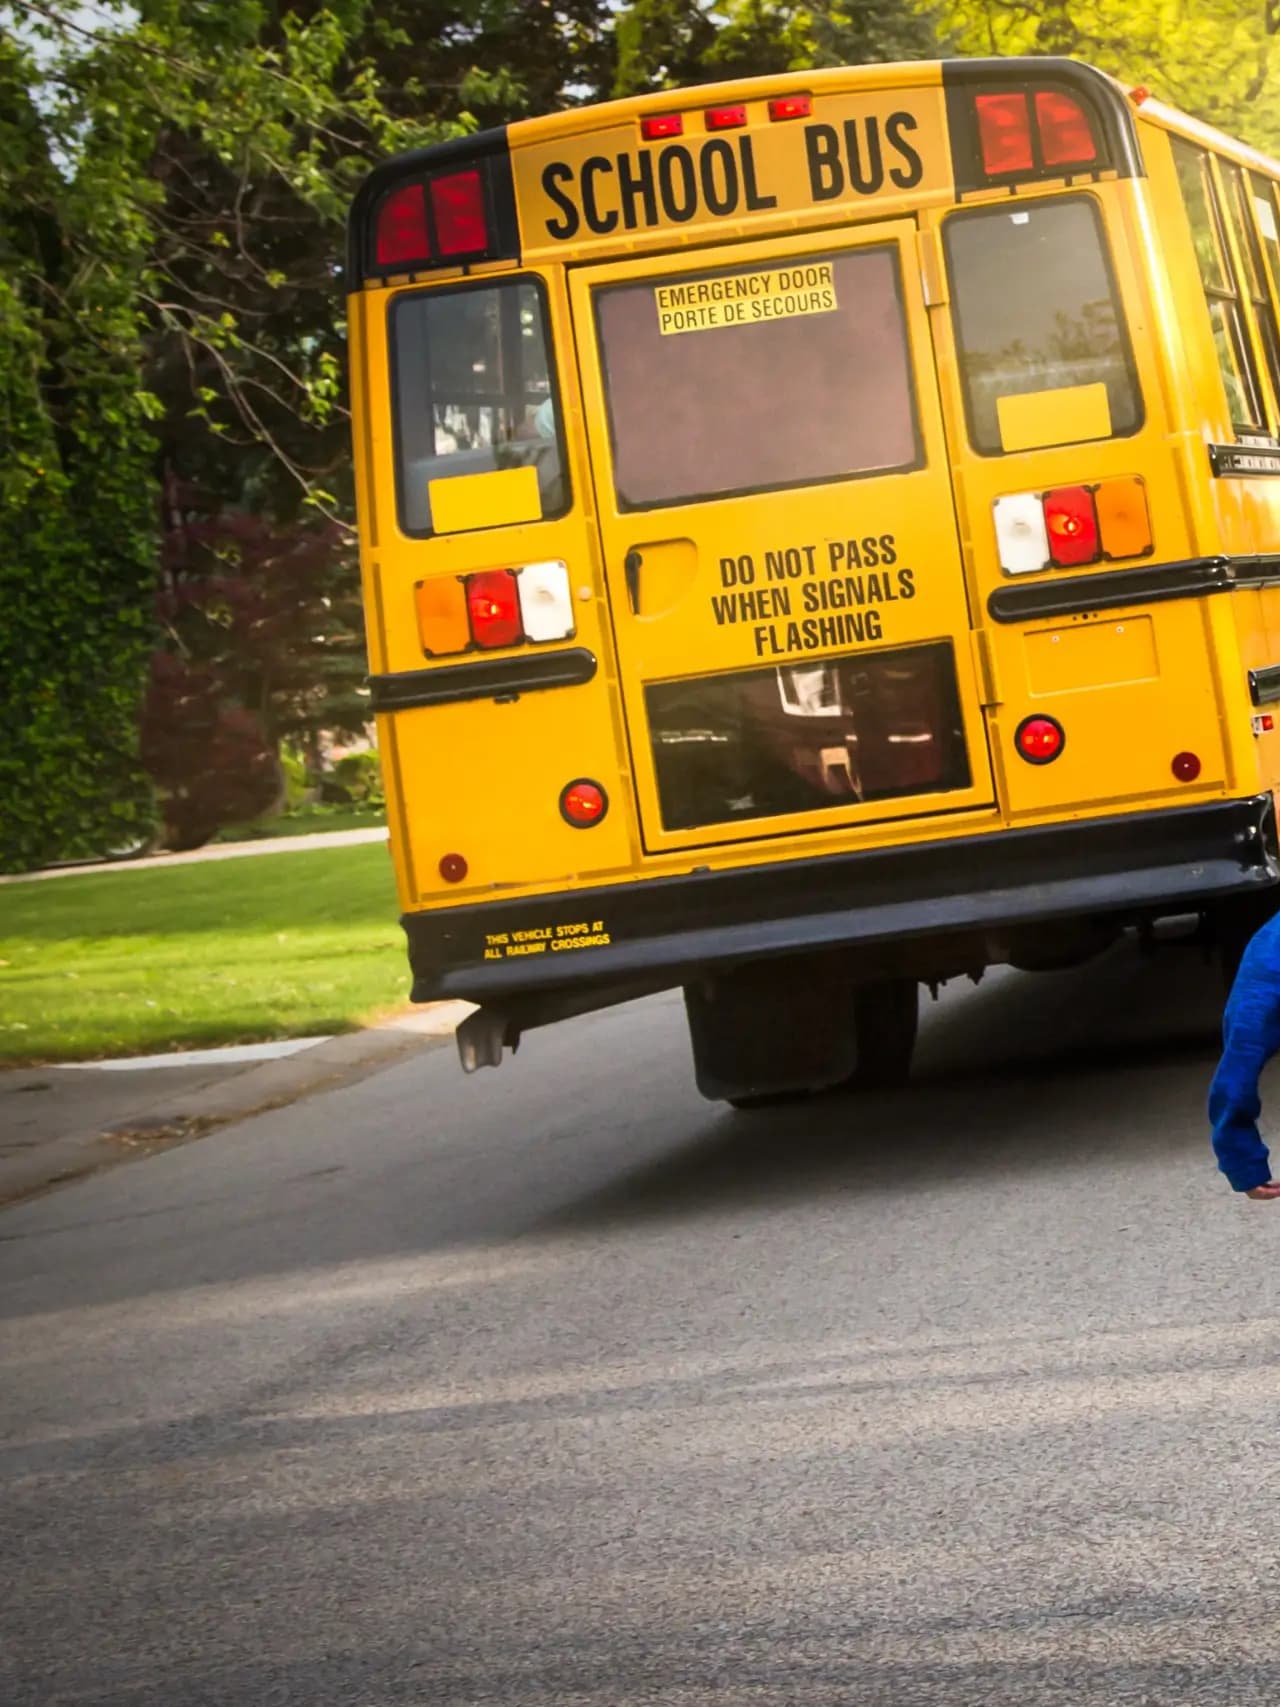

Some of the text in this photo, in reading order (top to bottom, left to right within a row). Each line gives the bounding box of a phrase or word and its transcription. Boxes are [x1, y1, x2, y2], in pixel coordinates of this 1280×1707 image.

[541, 111, 924, 240] SCHOOL BUS
[658, 266, 832, 309] EMERGENCY DOOR
[662, 290, 833, 332] PORTE DE SECOURS
[719, 534, 897, 588] DO NOT PASS
[711, 568, 916, 626] WHEN SIGNALS
[754, 610, 883, 657] FLASHING
[484, 947, 503, 959] ALL
[551, 933, 610, 951] CROSSINGS
[485, 920, 604, 945] THIS VEHICLE STOPS AT
